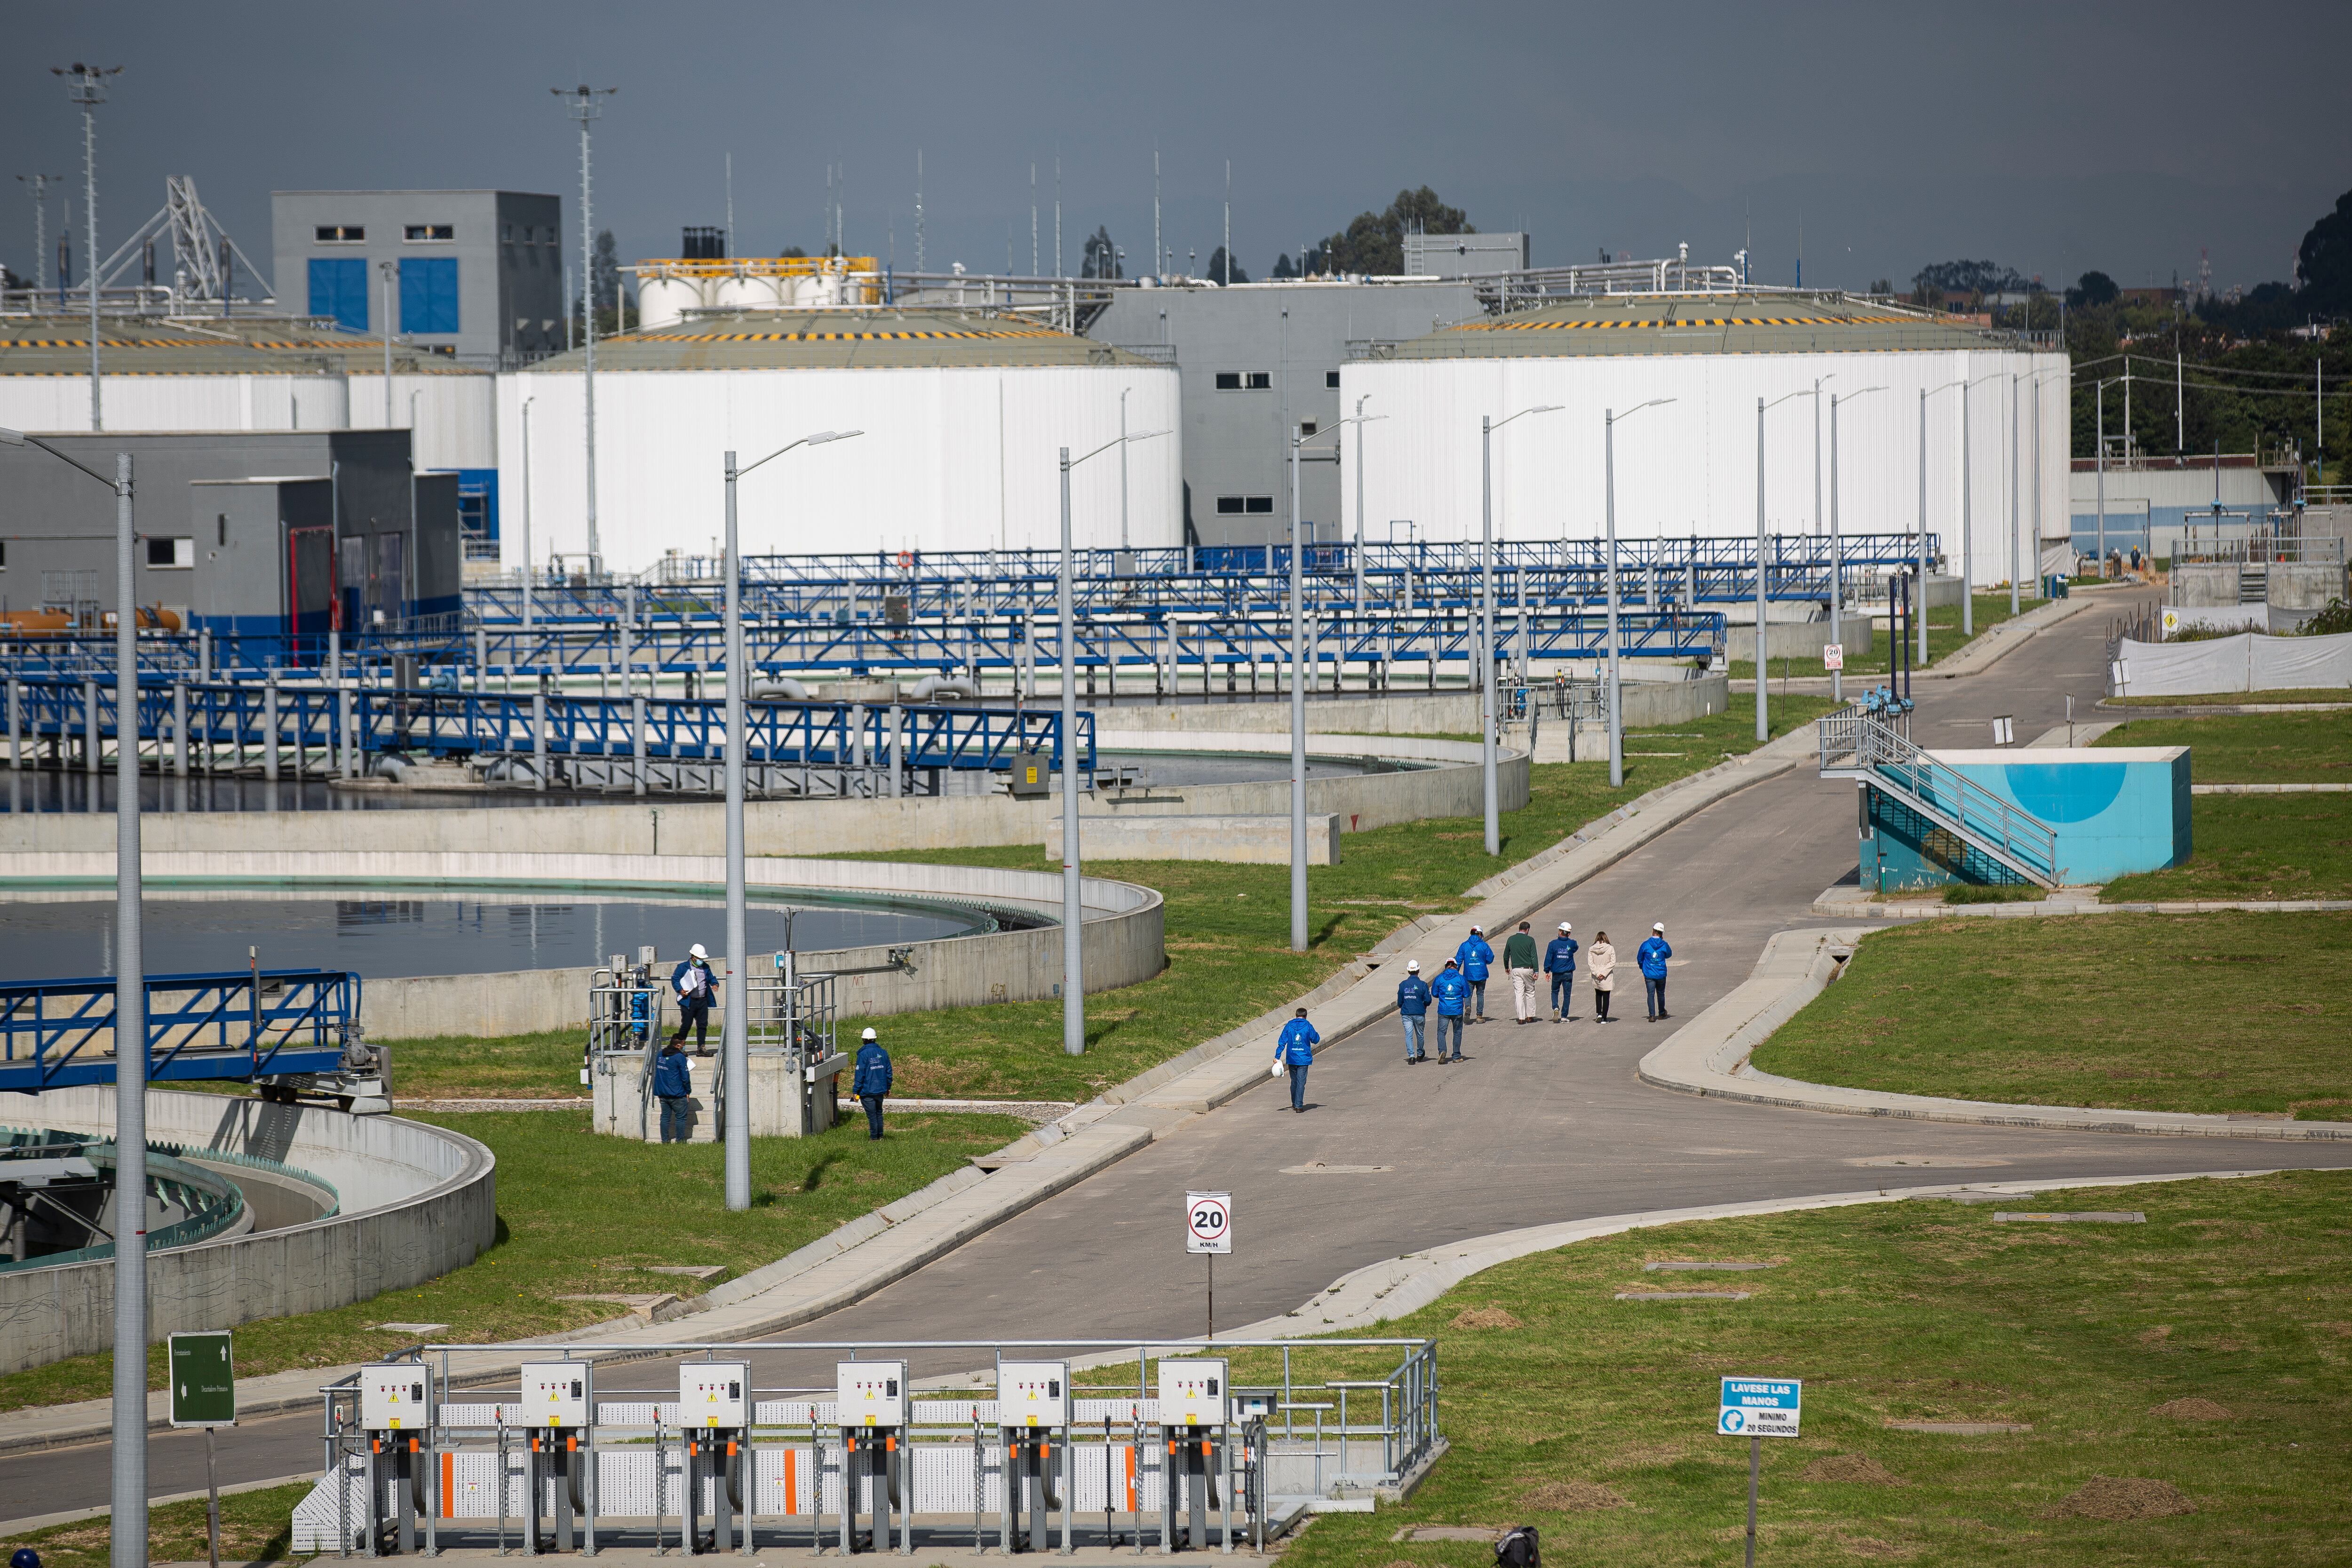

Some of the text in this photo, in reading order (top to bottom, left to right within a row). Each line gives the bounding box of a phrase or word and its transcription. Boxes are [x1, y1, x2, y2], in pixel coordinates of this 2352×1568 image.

[1194, 1211, 1223, 1228] 20
[1731, 1383, 1790, 1394] LAVESE LAS
[1741, 1396, 1779, 1406] MANOS
[1758, 1412, 1787, 1421] MINIMO
[1757, 1425, 1797, 1433] SEGUNDOS
